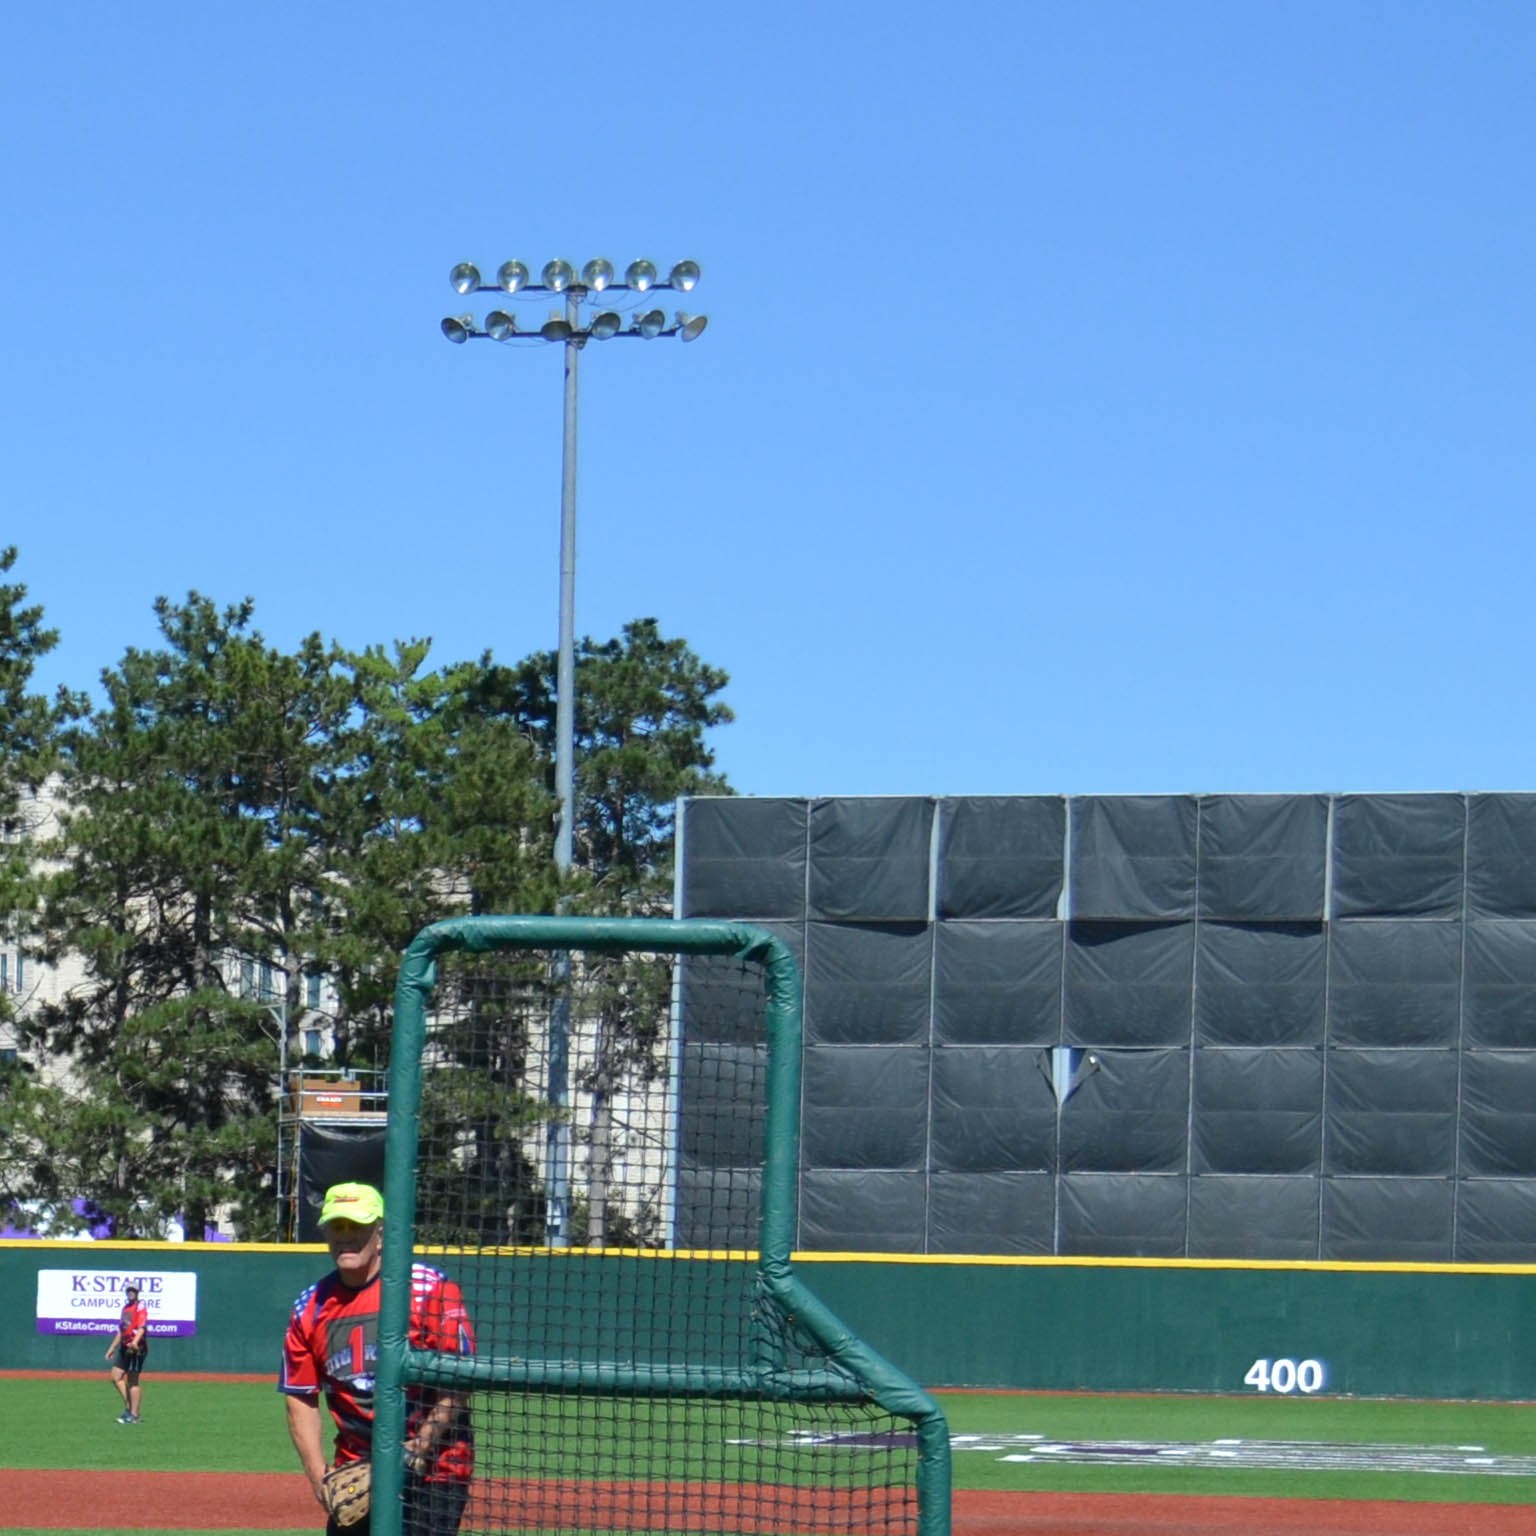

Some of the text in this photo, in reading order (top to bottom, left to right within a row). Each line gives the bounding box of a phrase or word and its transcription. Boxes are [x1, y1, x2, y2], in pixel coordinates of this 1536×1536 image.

[71, 1297, 121, 1309] CAMPUS
[348, 1325, 365, 1374] 1
[1243, 1358, 1323, 1393] 400
